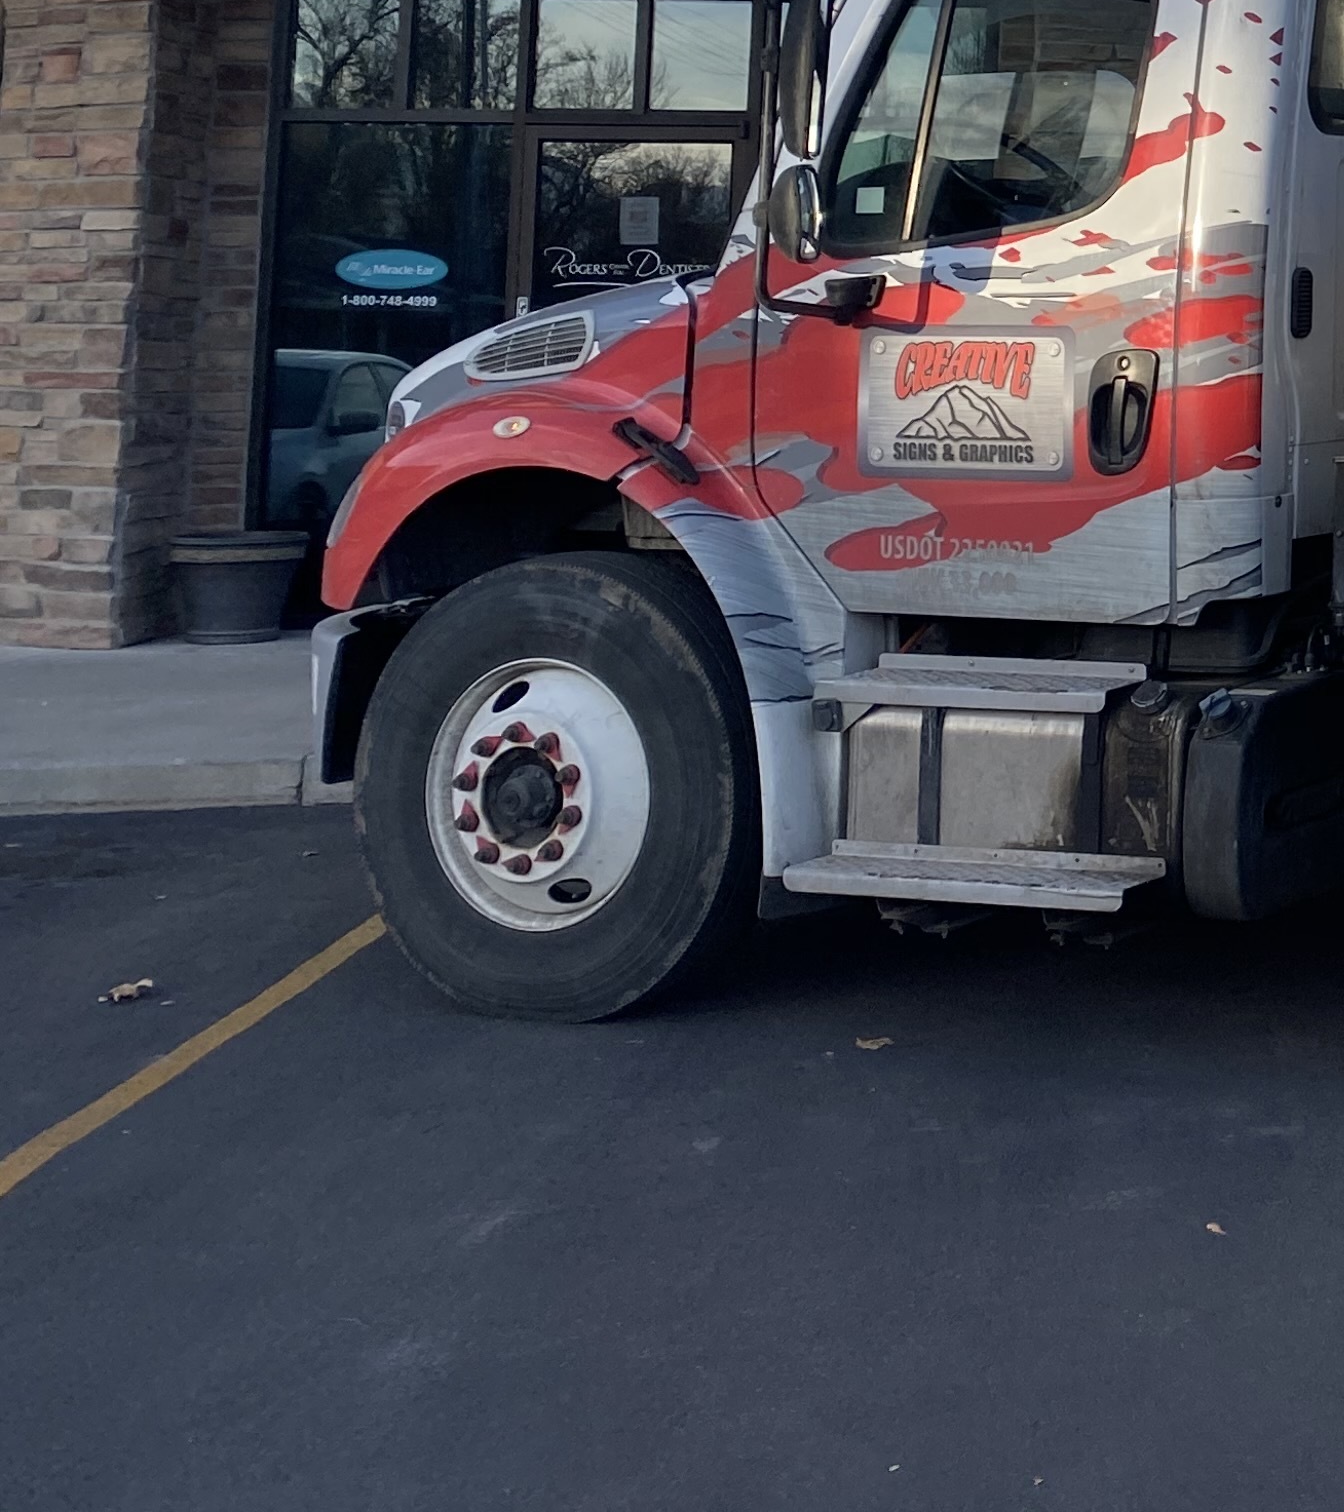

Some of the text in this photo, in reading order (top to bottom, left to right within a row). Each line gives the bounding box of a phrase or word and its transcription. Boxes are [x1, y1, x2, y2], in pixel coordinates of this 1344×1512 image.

[373, 265, 437, 275] Miracle-Ear
[544, 246, 608, 279] ROGERS
[341, 294, 438, 307] 1-800-748-4999
[894, 340, 1036, 400] CREATIVE
[893, 442, 1034, 464] SIGNS & GRAPHICS
[879, 534, 945, 561] USDOT
